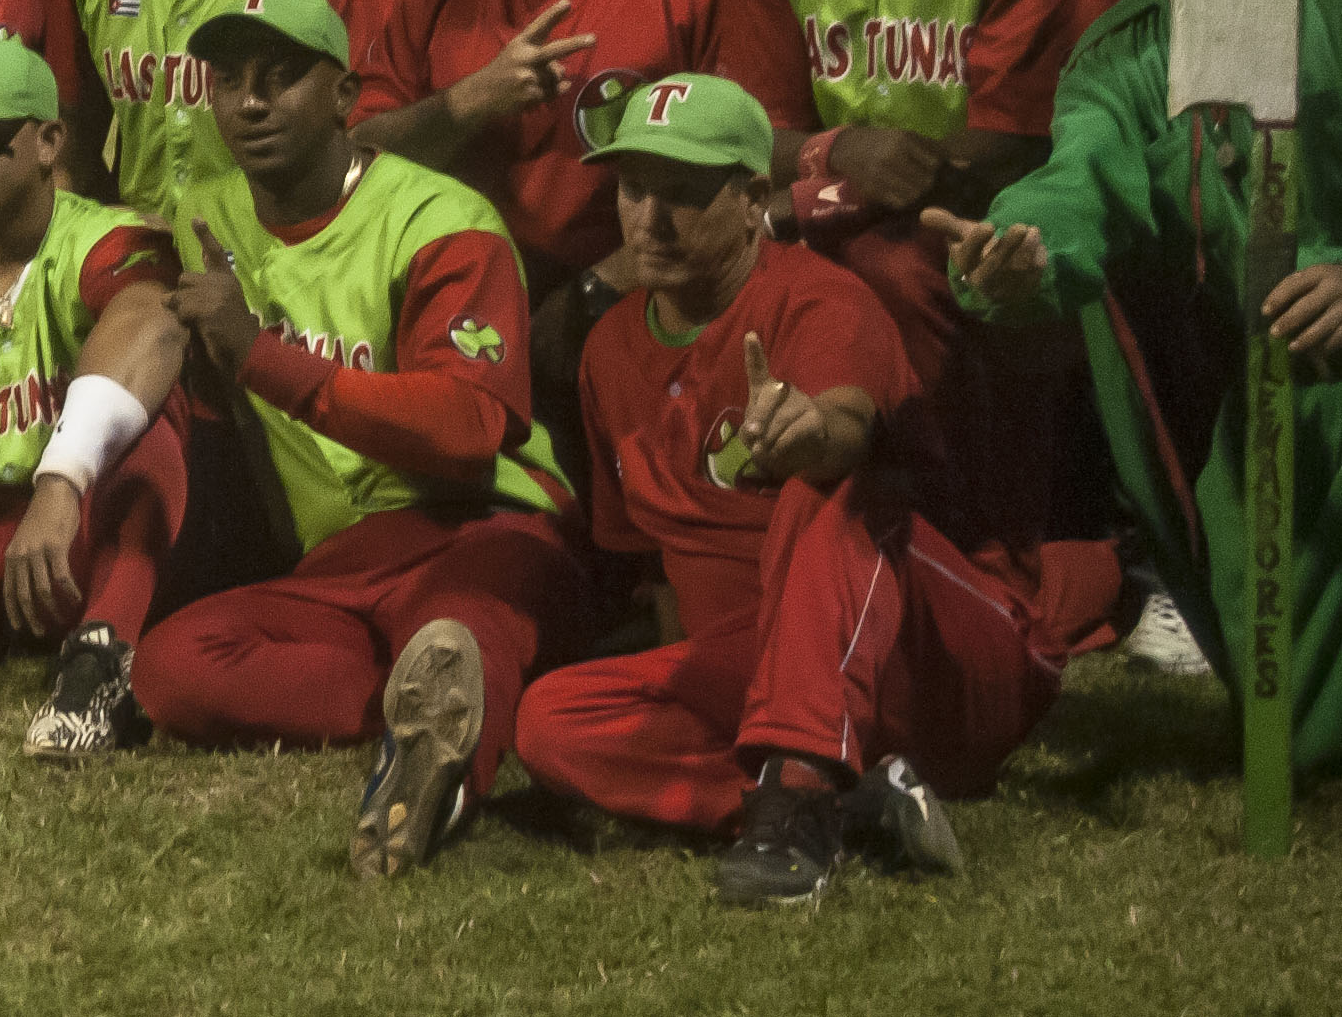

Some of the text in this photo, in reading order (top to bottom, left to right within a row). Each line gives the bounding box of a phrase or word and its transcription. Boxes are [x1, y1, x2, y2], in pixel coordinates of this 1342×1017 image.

[103, 47, 157, 102] LAS
[805, 15, 853, 83] AS
[646, 83, 692, 126] T
